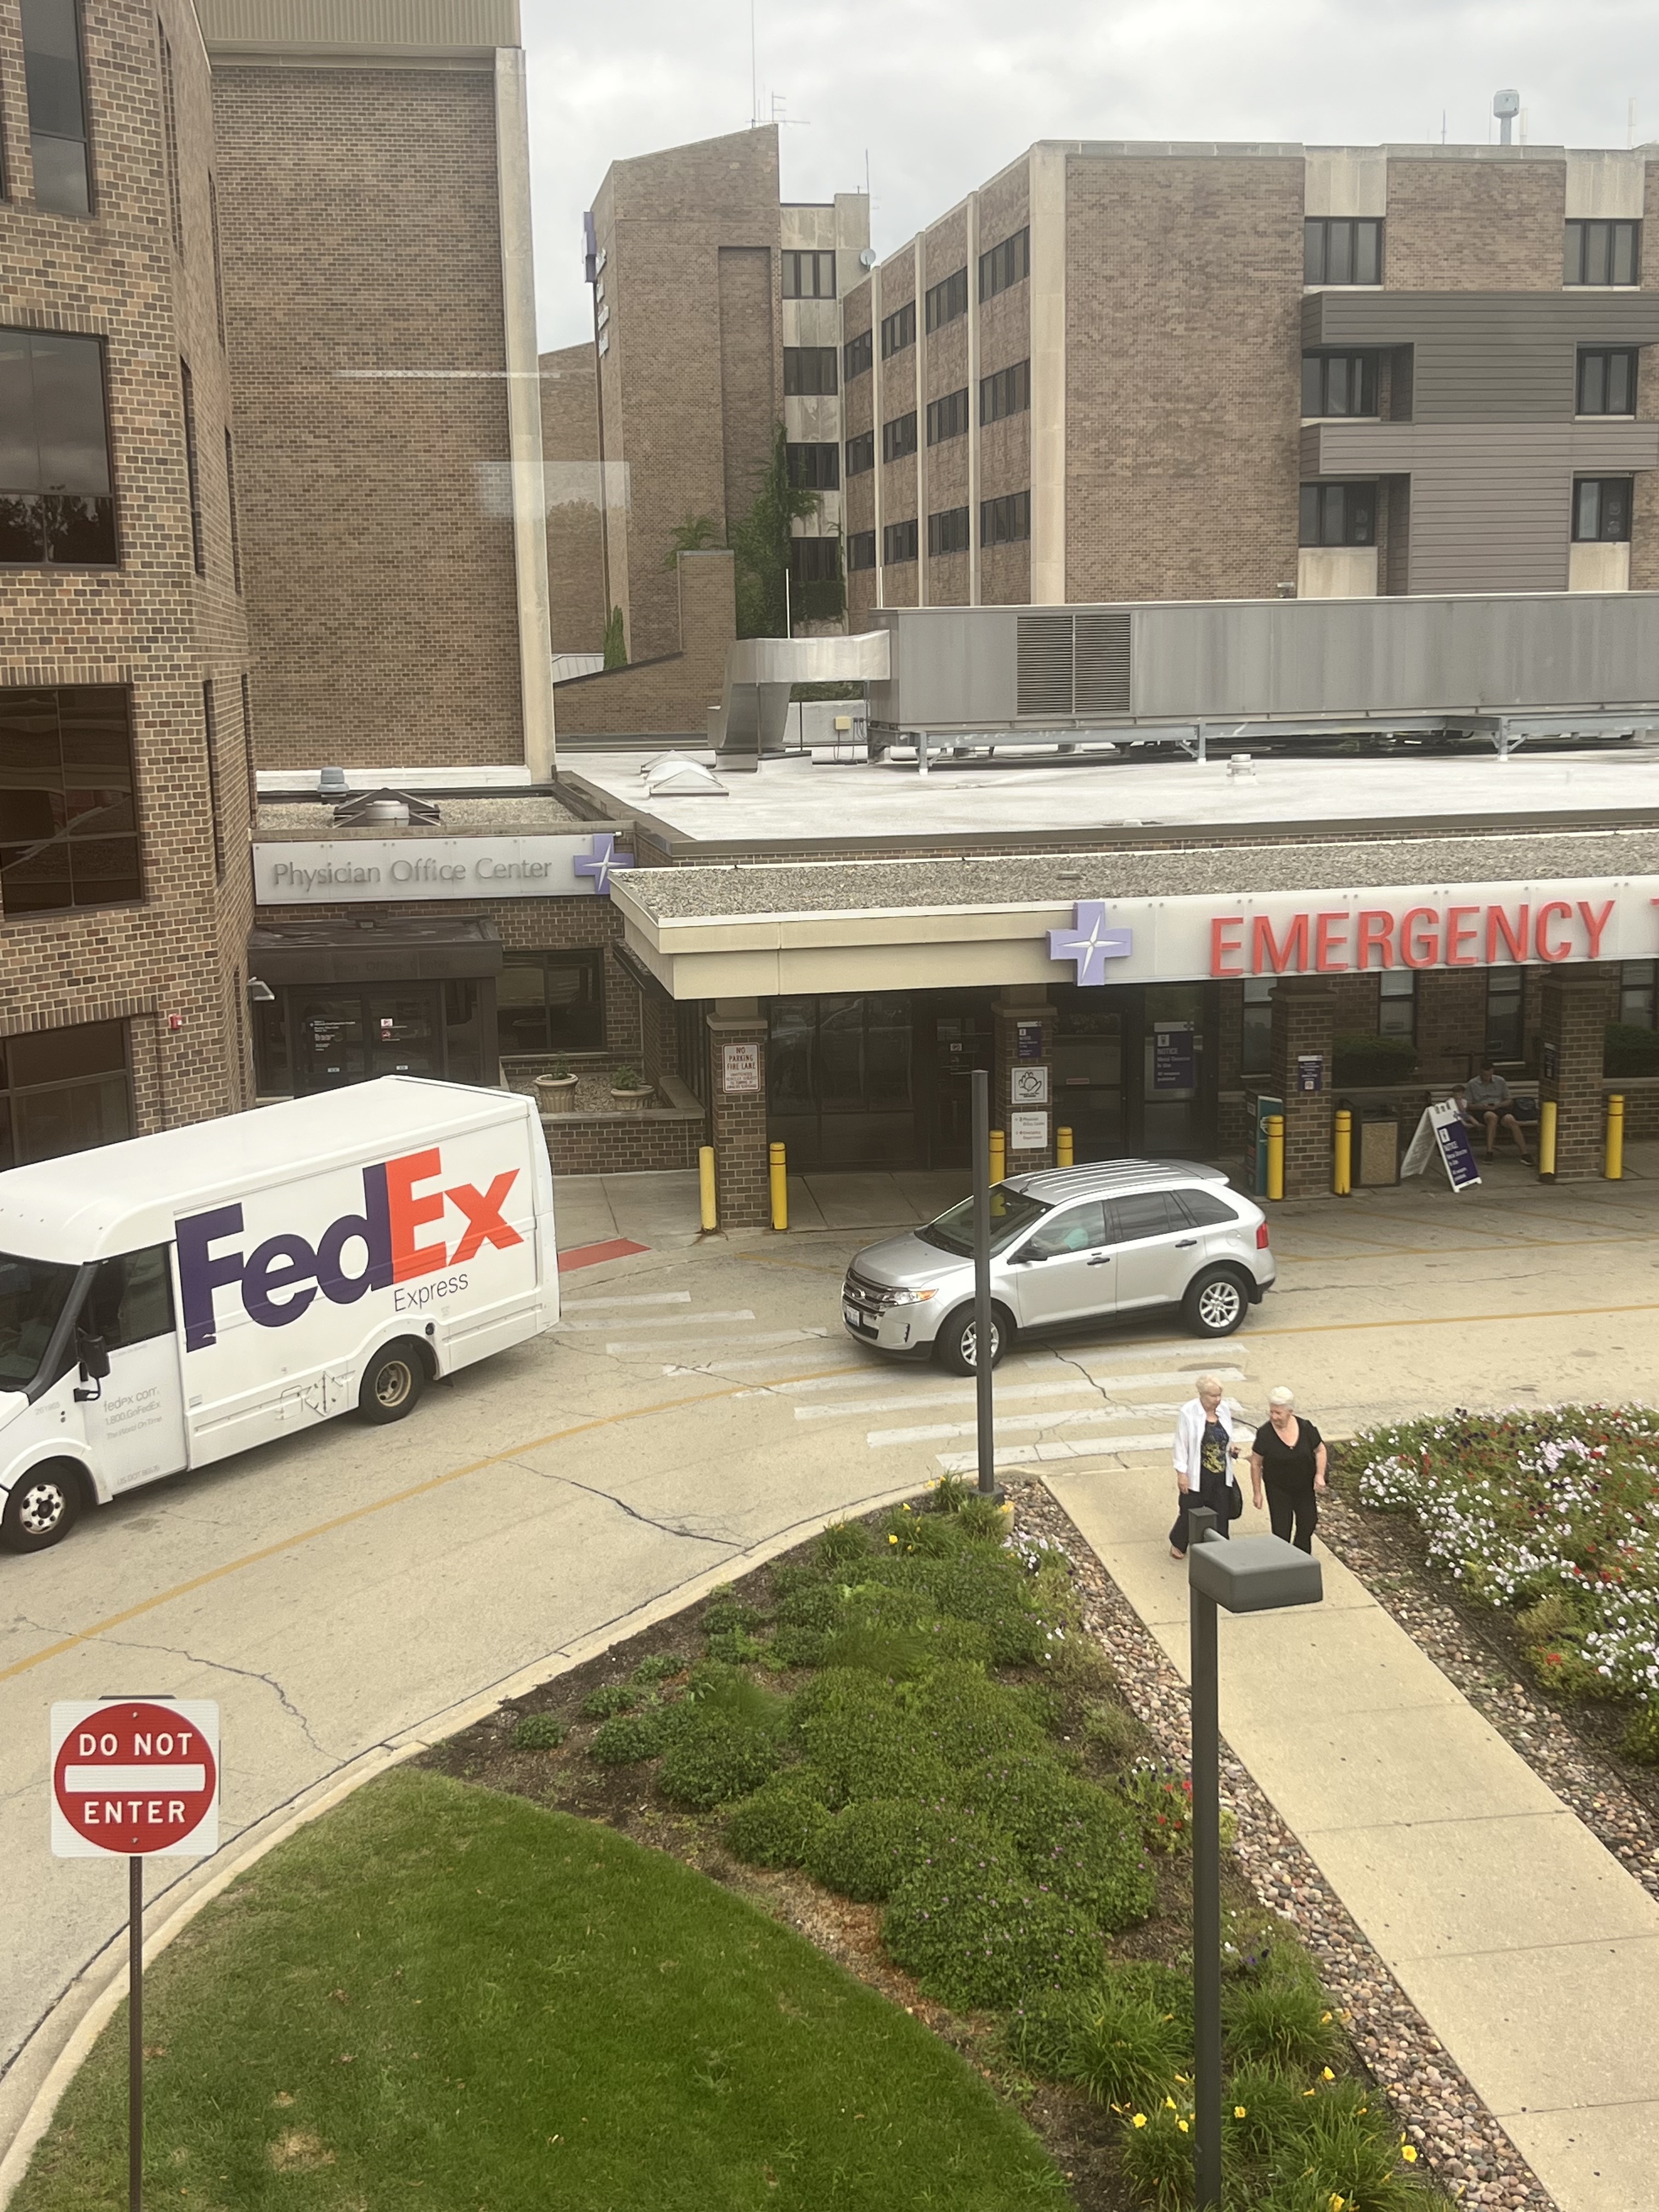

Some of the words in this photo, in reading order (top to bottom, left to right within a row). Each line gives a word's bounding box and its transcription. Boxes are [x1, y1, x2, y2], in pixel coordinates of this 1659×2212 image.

[274, 862, 381, 893] Physician
[391, 858, 466, 882] Office
[475, 857, 552, 879] Center
[1210, 900, 1616, 977] EMERGENCY
[174, 1147, 524, 1353] FedEx
[394, 1273, 469, 1312] Express
[79, 1733, 118, 1756] DO
[134, 1733, 193, 1756] NOT
[84, 1801, 185, 1824] ENTER
